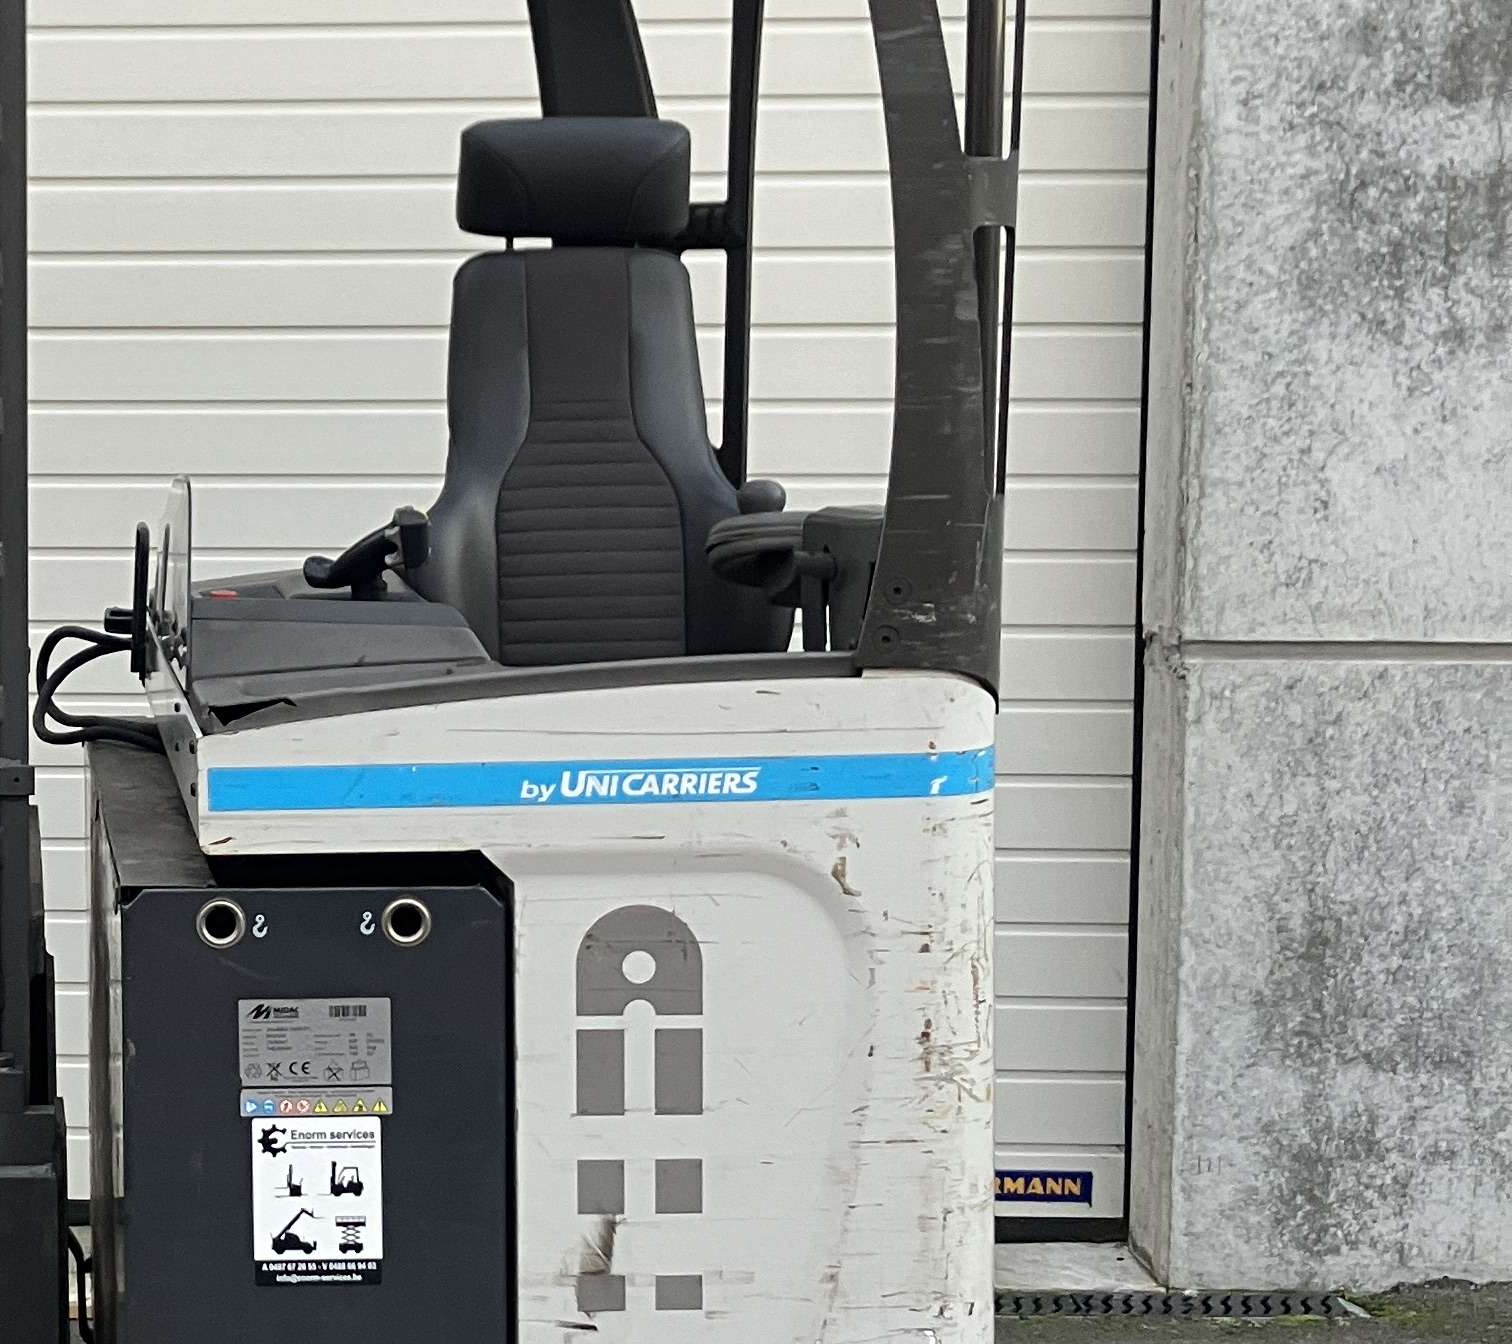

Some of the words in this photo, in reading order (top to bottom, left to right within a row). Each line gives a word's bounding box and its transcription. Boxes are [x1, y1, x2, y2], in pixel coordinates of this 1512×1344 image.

[520, 780, 556, 802] by
[560, 767, 762, 797] UNICARRIERS
[290, 1129, 327, 1140] Enorm
[329, 1129, 375, 1140] services
